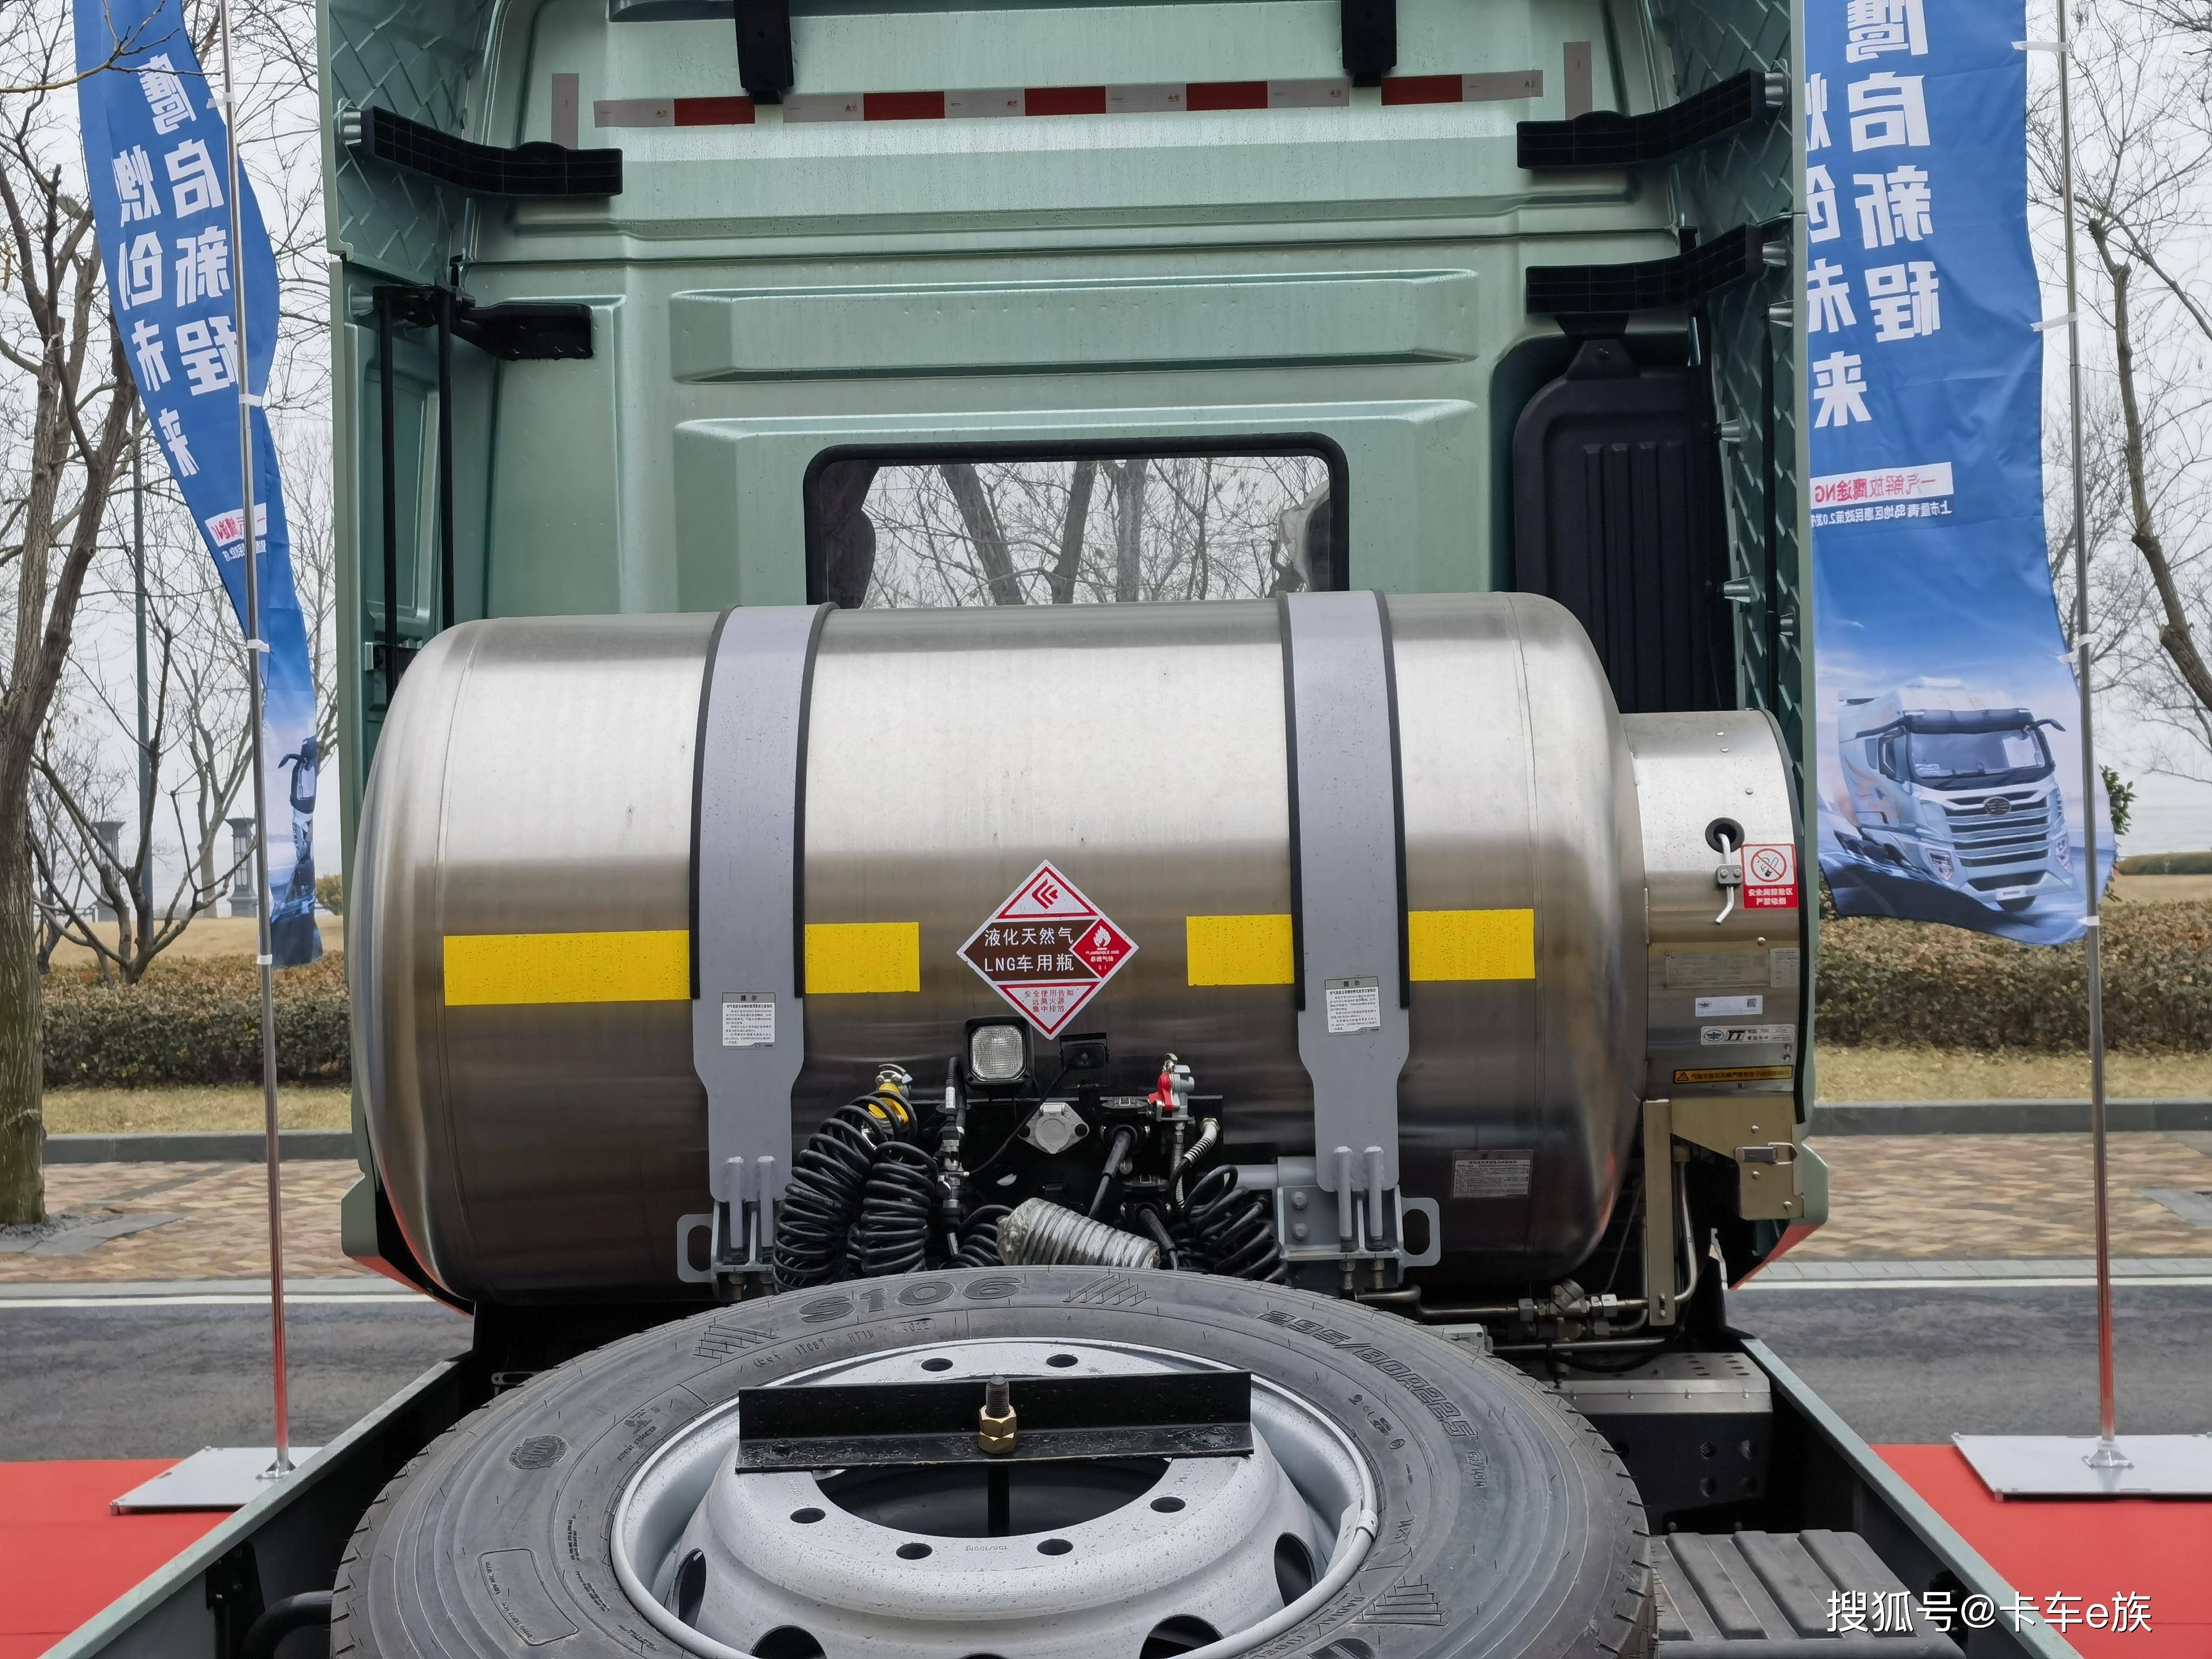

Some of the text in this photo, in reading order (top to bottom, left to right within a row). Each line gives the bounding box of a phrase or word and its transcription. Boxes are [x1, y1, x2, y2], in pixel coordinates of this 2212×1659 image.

[984, 927, 1074, 947] 液化天然气
[984, 953, 1075, 972] LNG车用瓶
[1024, 989, 1074, 998] 安全使用告知
[1033, 997, 1065, 1005] 远离火源
[799, 1276, 1024, 1323] S106
